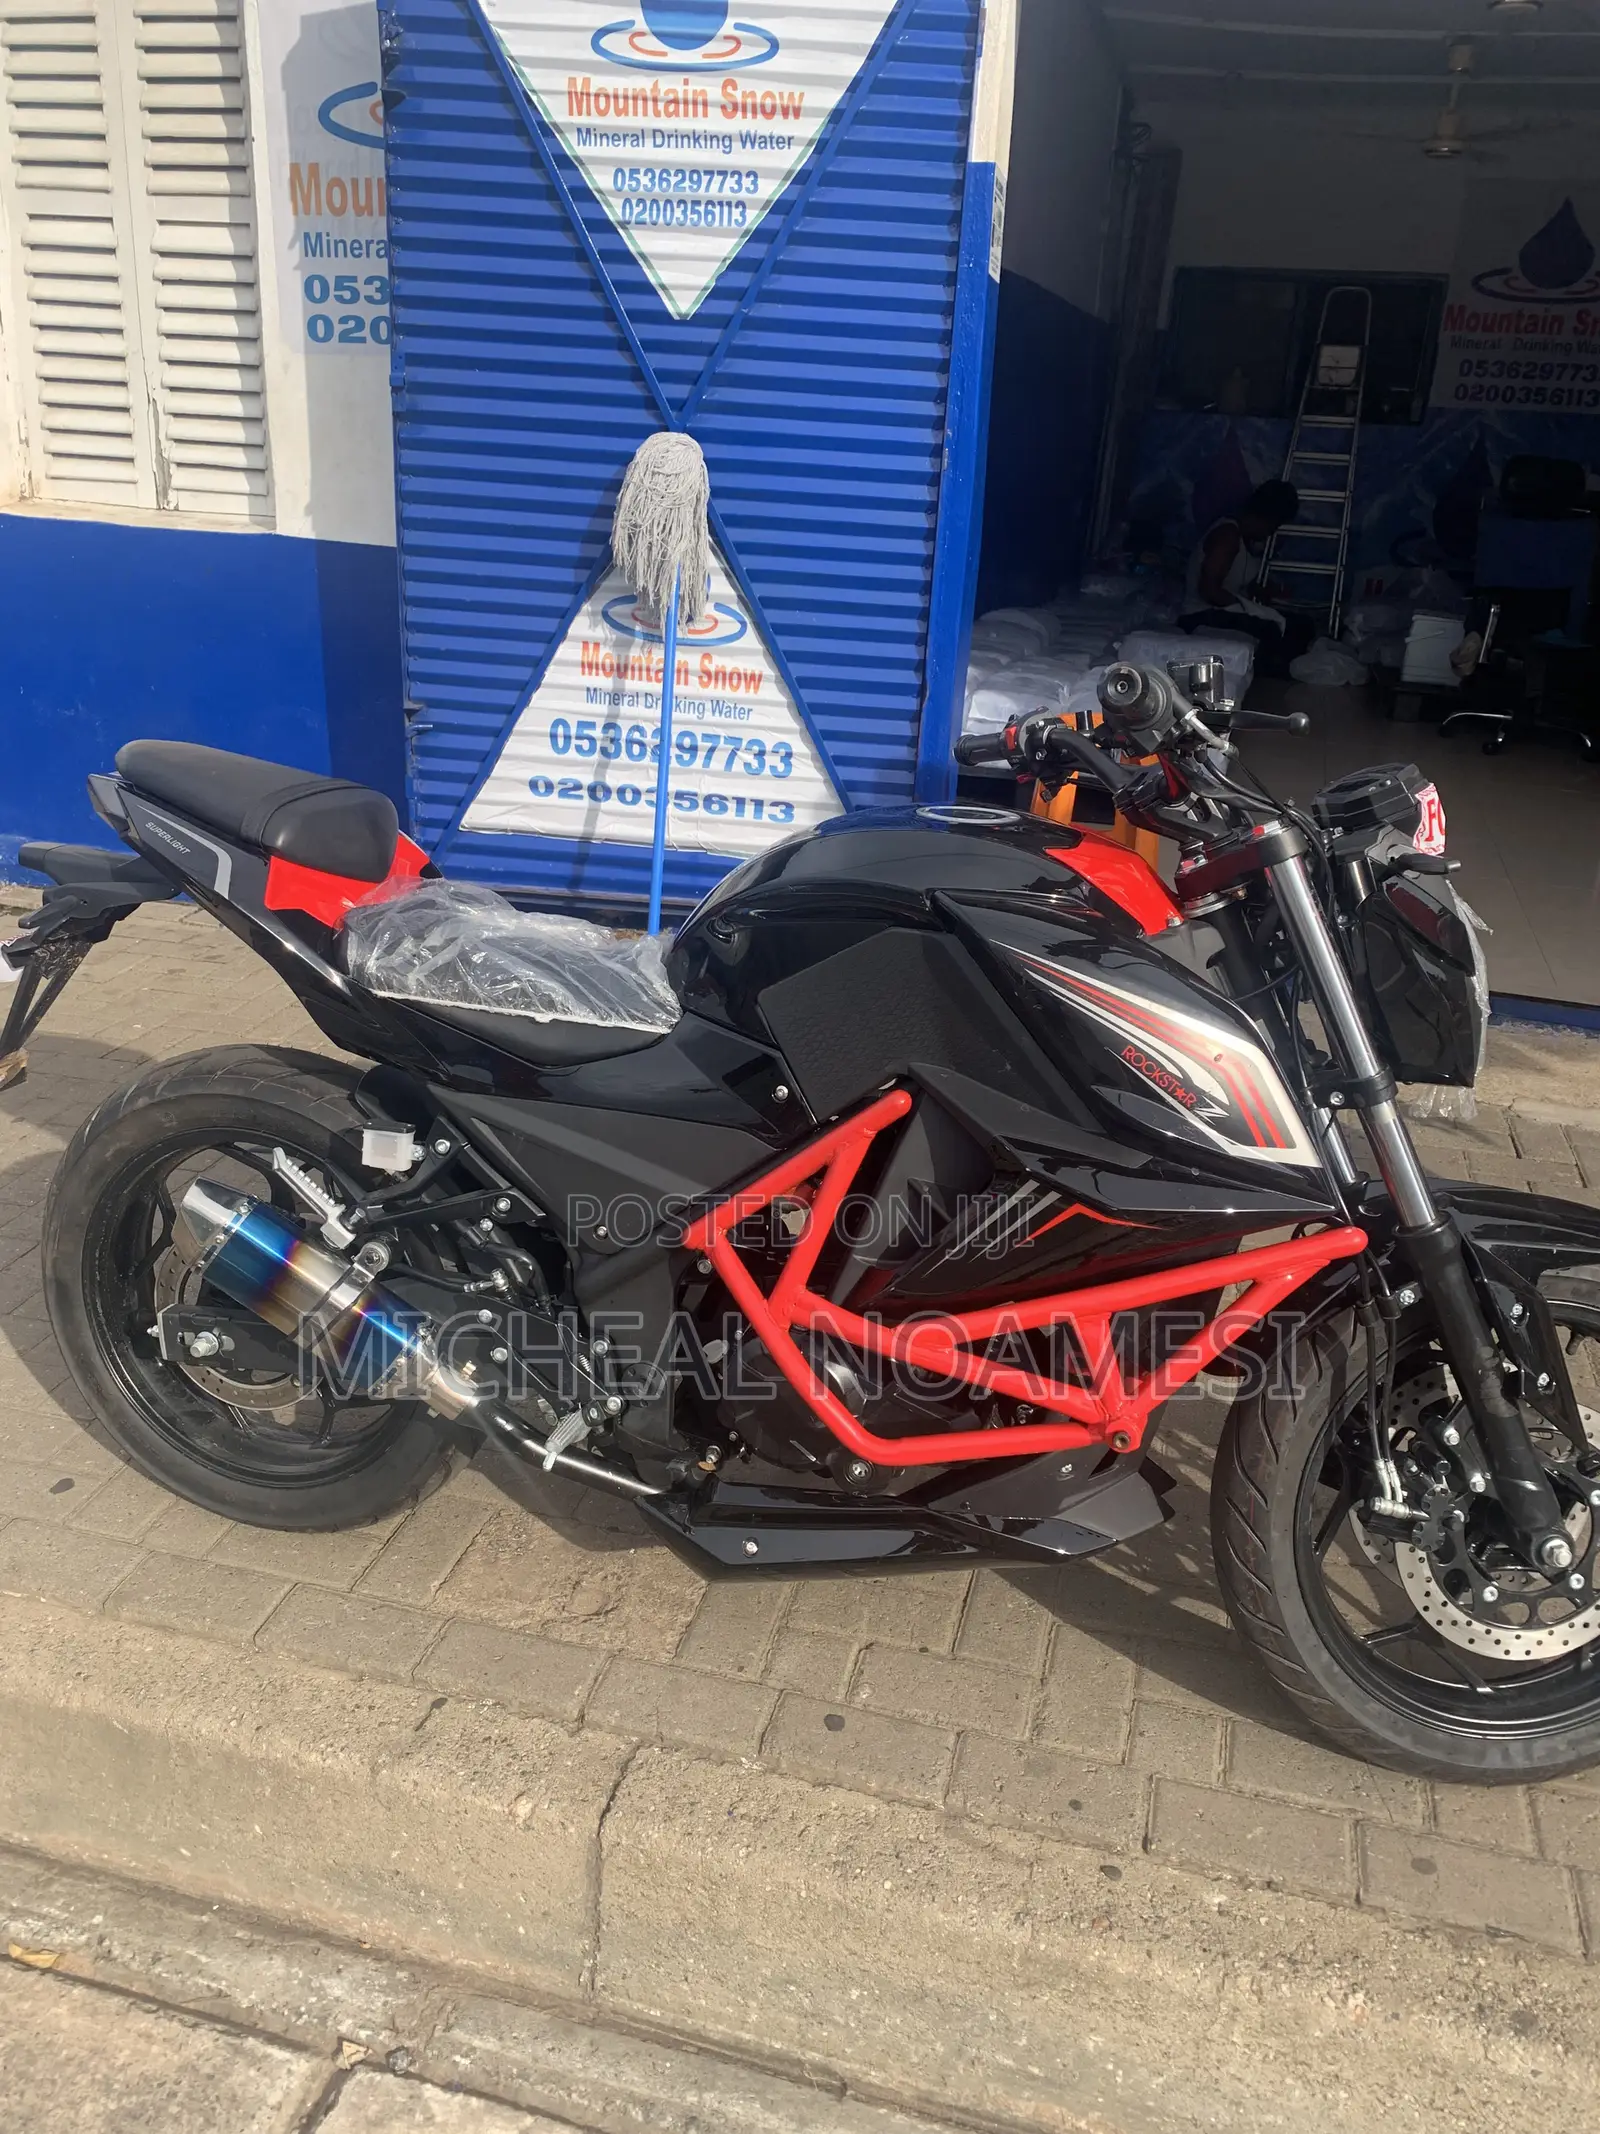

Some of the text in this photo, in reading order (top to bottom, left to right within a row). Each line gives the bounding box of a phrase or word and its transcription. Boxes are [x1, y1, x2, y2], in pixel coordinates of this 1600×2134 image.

[567, 76, 805, 120] Mountain Snow
[576, 127, 795, 154] Mineral Drinking Water
[612, 167, 759, 194] 0536297733
[621, 197, 747, 227] 0200356113
[1443, 303, 1565, 335] Mountain
[1450, 335, 1500, 350] Mineral
[1513, 336, 1573, 356] Drinking
[1459, 359, 1600, 383] 053629773
[580, 641, 763, 695] Mountan Snow
[586, 687, 753, 721] Mineral Drking Water
[145, 821, 191, 854] SUPERLIGHT
